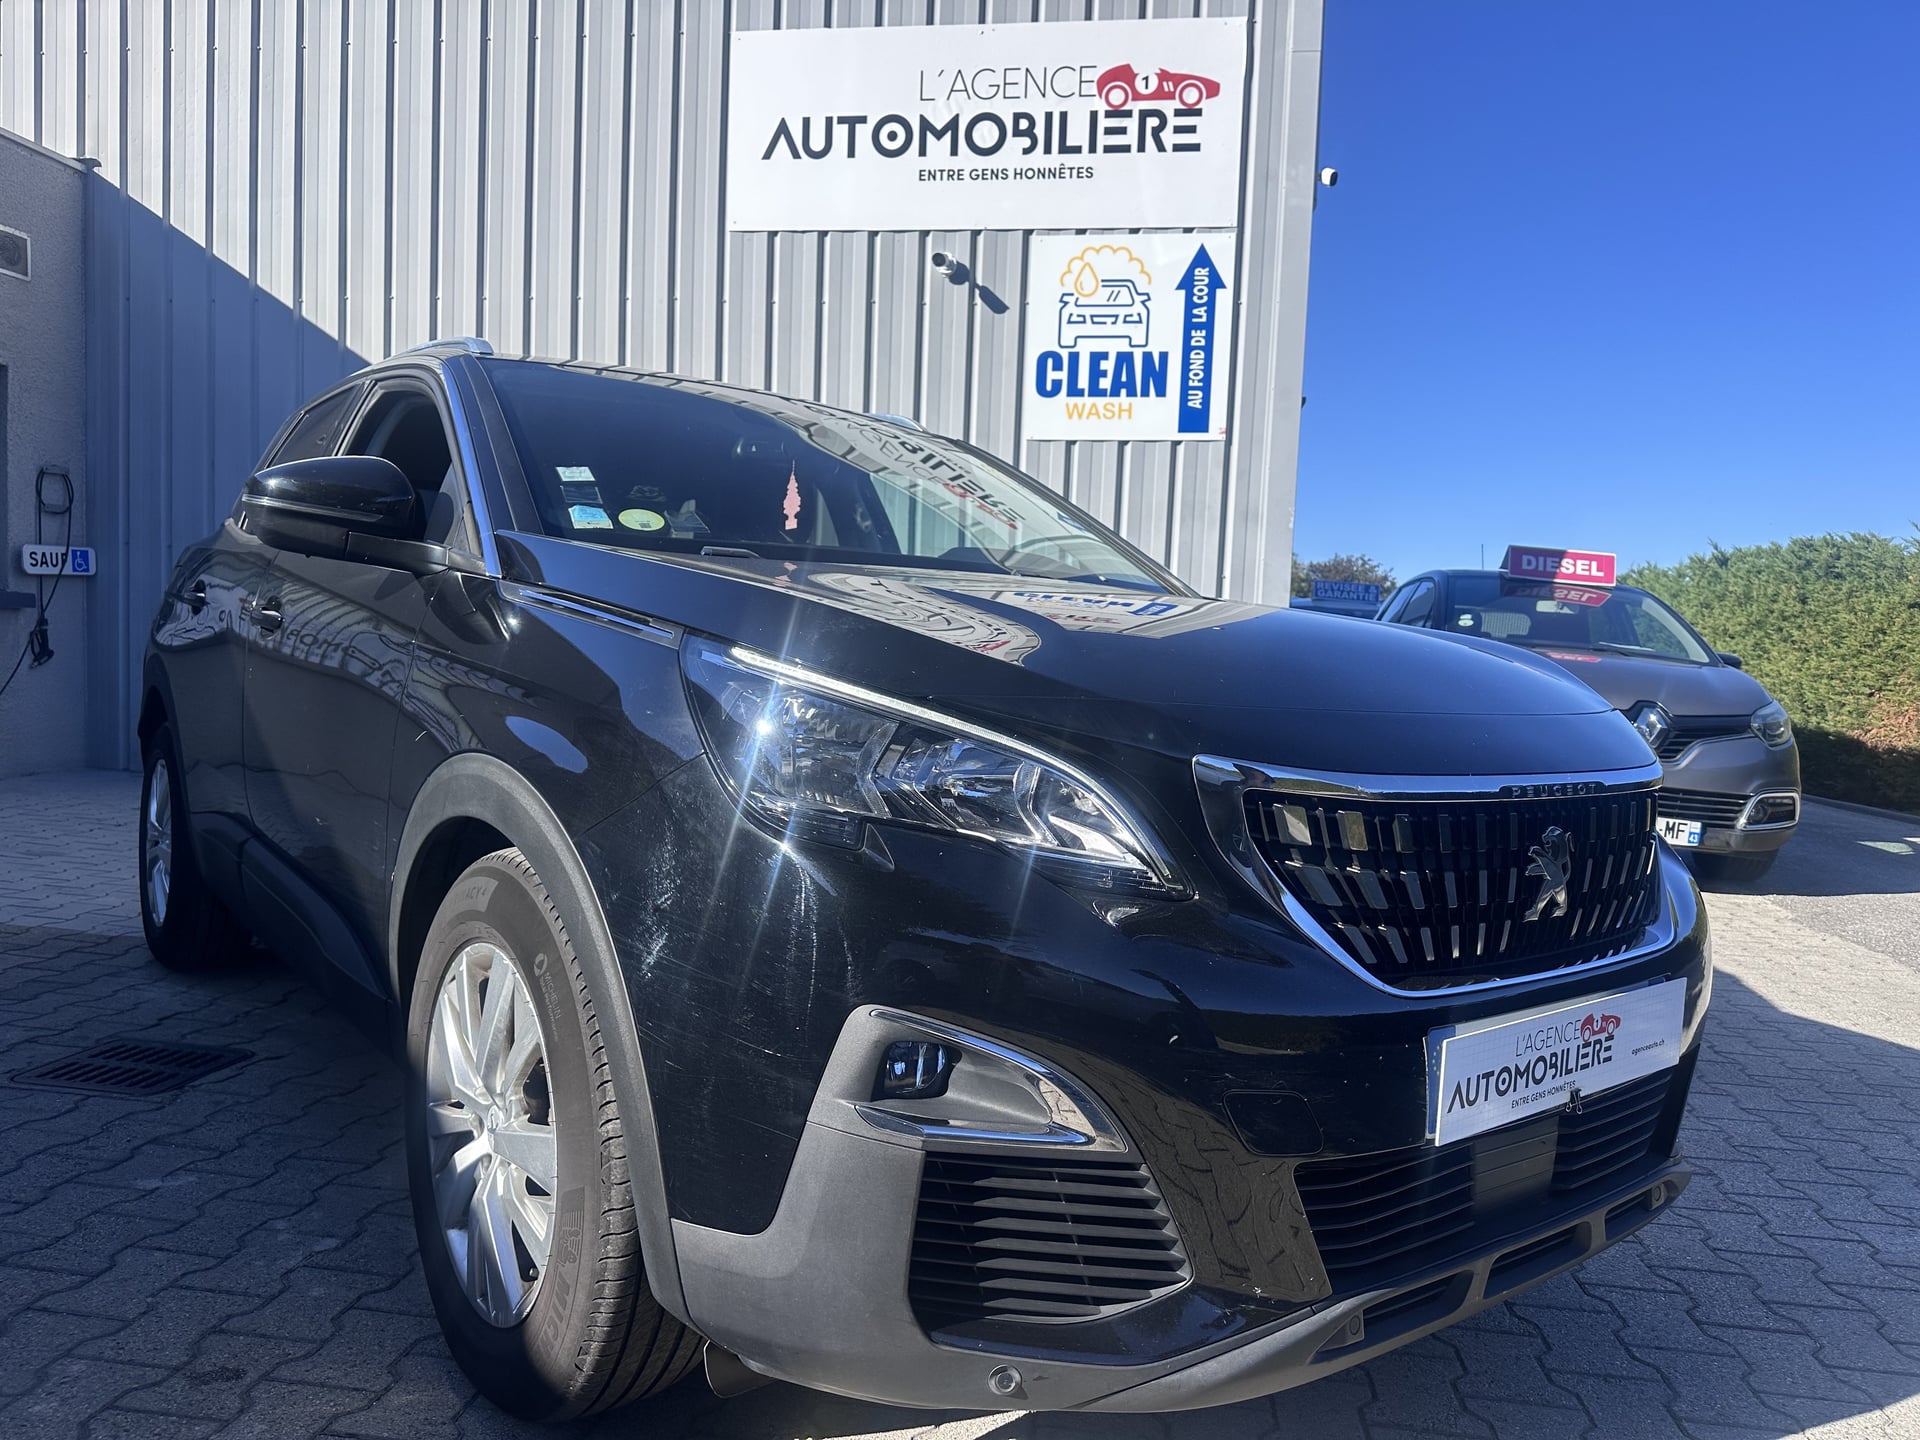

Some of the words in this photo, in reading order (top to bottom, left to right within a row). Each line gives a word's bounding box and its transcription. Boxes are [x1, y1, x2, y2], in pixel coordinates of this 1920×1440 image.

[919, 65, 1097, 102] L'AGENCE
[1141, 75, 1150, 90] 1
[918, 168, 965, 182] ENTRE
[969, 167, 1009, 181] GENS
[1013, 163, 1094, 180] HONNÊTES
[1192, 267, 1210, 303] COUR
[1192, 306, 1208, 323] LA
[1190, 329, 1206, 346] DE
[1035, 350, 1169, 399] CLEAN
[1188, 349, 1205, 387] FOND
[1187, 390, 1204, 409] AU
[1065, 402, 1133, 420] WASH
[1521, 554, 1605, 577] DIESEL
[1511, 783, 1597, 798] PEUGEOT
[1515, 1019, 1582, 1057] L'AGENCE
[1511, 1094, 1530, 1109] ENTRE
[1530, 1090, 1547, 1102] GENS
[1547, 1080, 1577, 1096] HONNÊTES
